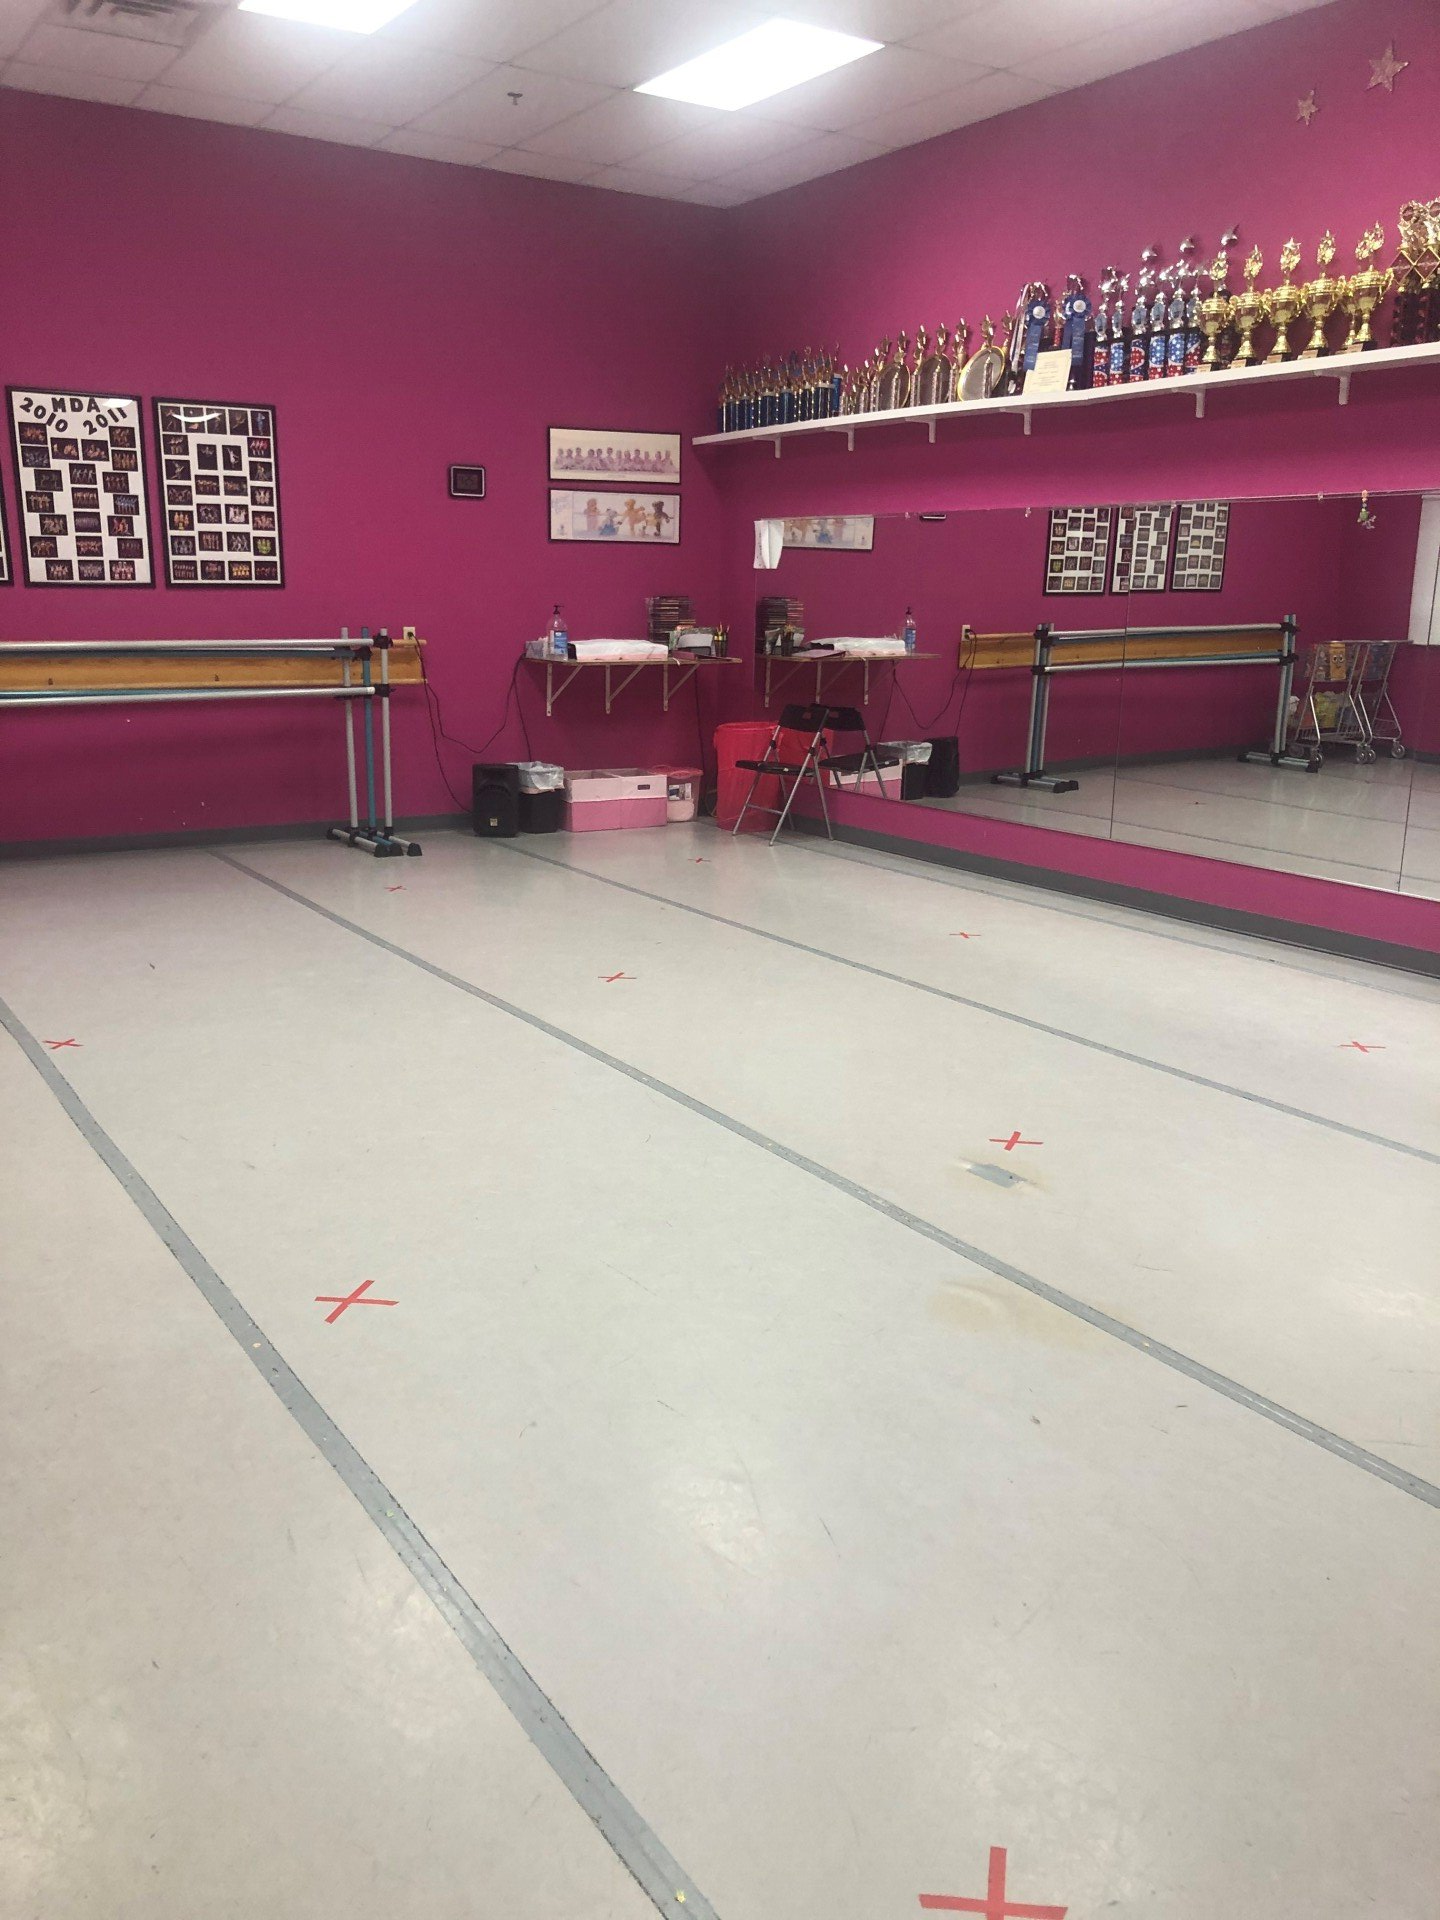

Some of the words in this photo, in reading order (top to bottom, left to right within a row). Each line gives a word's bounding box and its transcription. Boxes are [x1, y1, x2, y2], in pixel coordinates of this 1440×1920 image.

[20, 397, 68, 432] 2010
[83, 407, 127, 435] 2011
[51, 397, 100, 412] MDA
